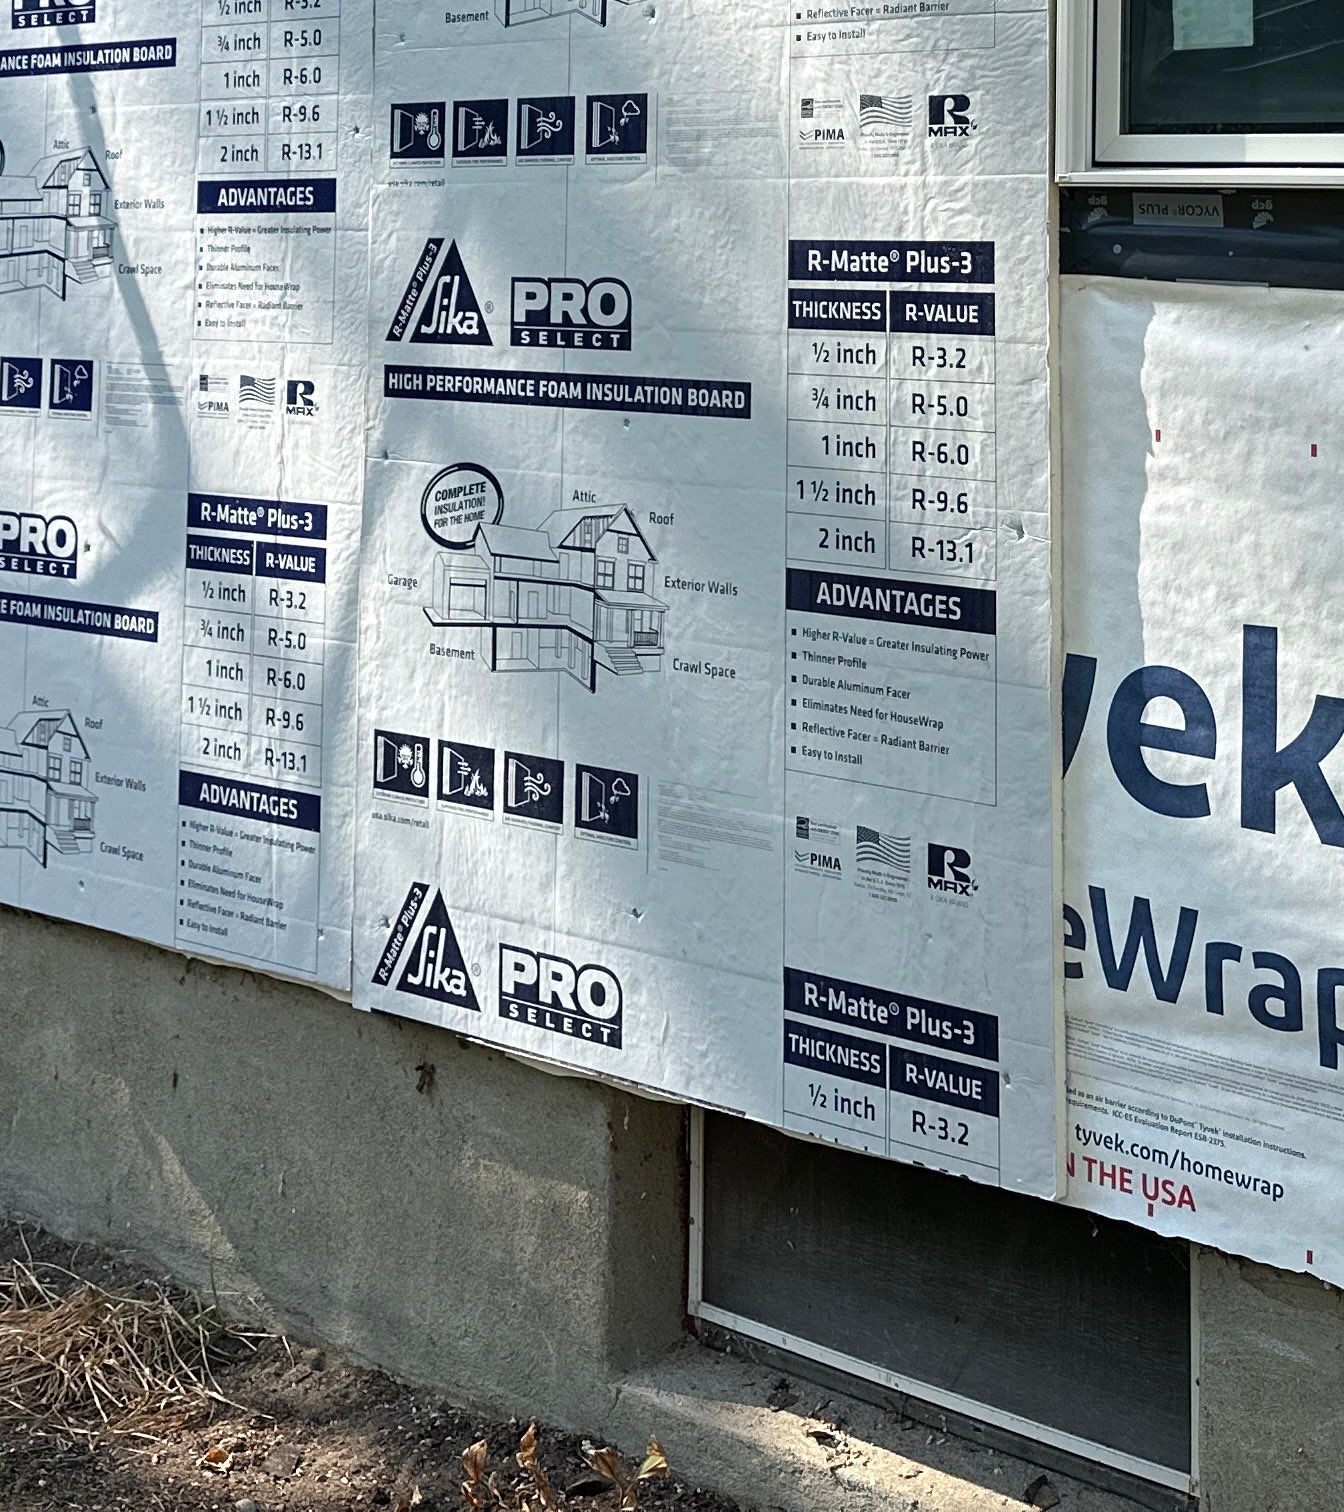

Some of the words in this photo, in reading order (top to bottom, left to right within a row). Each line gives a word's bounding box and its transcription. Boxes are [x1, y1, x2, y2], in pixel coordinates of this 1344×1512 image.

[18, 9, 91, 27] SELECT
[233, 33, 261, 52] inch
[285, 29, 322, 48] R-5.0
[220, 147, 228, 161] 2
[231, 145, 259, 163] inch
[281, 143, 323, 161] R-13.1
[906, 250, 973, 274] Plus-3
[793, 300, 881, 321] THICKNESS
[905, 303, 979, 323] R-VALUE
[834, 390, 877, 412] inch
[912, 393, 968, 417] R-5.0
[189, 545, 250, 566] THICKNESS
[265, 554, 316, 573] R-VALUE
[816, 582, 962, 621] ADVANTAGES
[215, 700, 242, 722] inch
[265, 711, 304, 732] R-9.6
[199, 783, 298, 820] ADVANTAGES
[502, 950, 621, 1023] PRO
[509, 1002, 614, 1044] SELECT
[905, 1010, 976, 1046] Plus-3
[833, 1090, 876, 1122] inch
[911, 1110, 970, 1147] R-3.2
[1075, 1124, 1284, 1202] tyvek.com/homewrap
[1082, 1156, 1133, 1195] THE
[1141, 1172, 1197, 1212] USA
